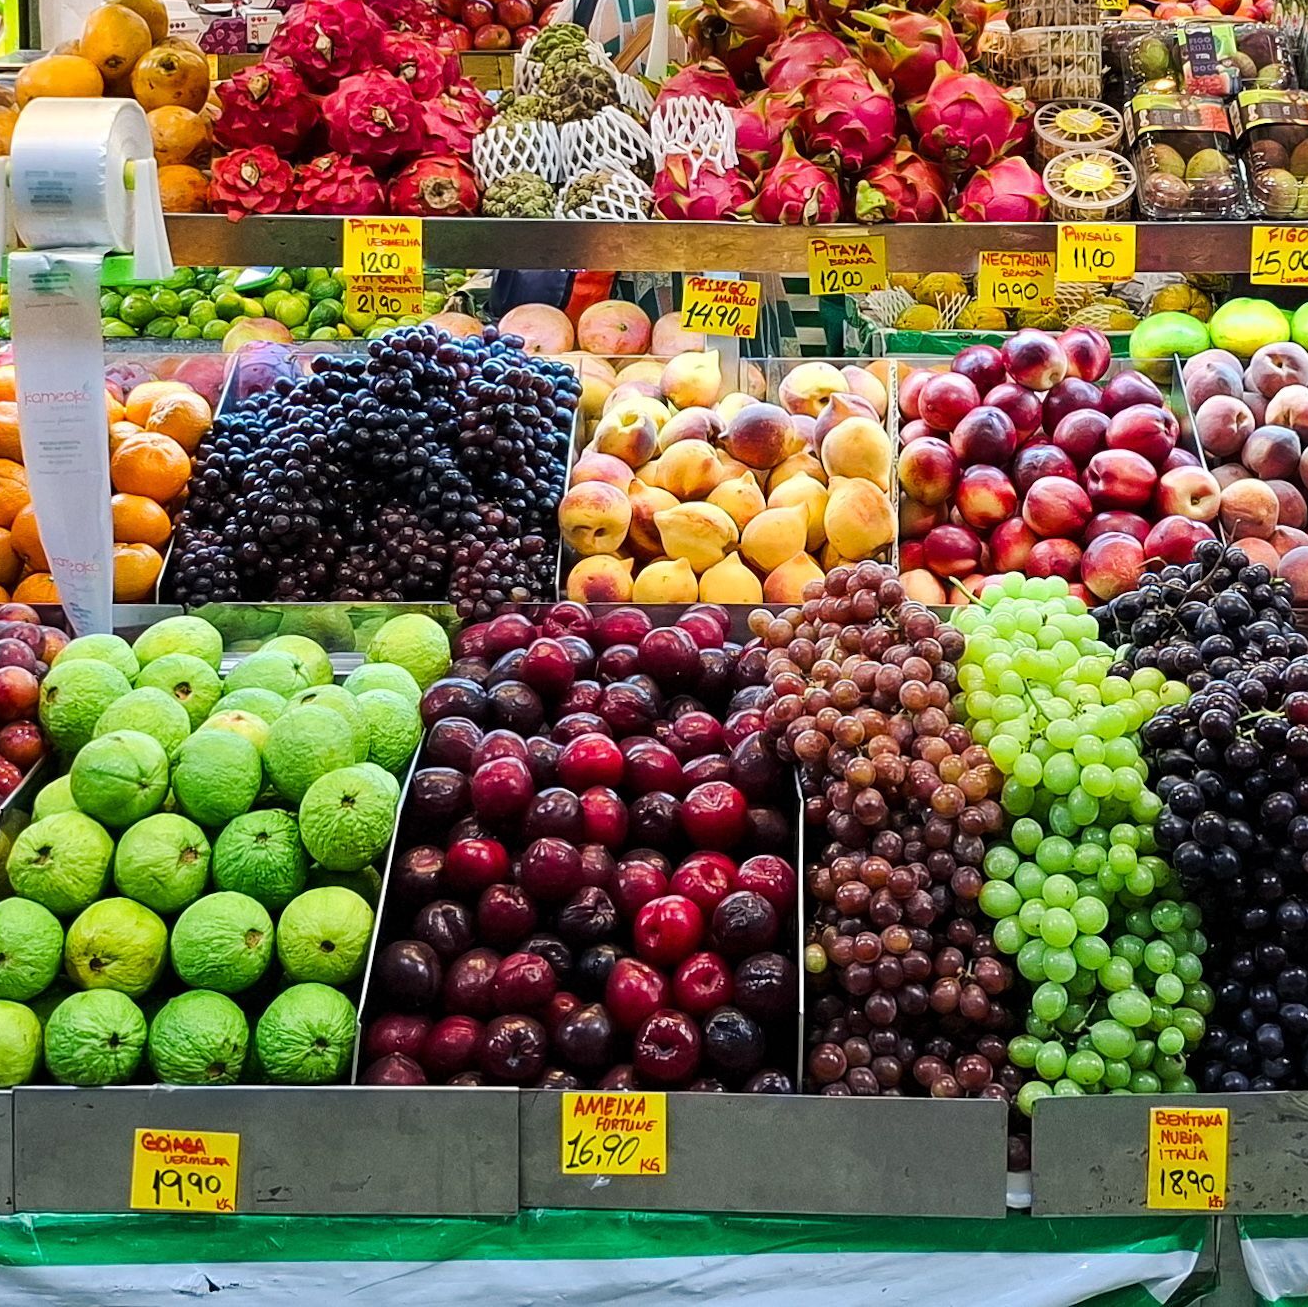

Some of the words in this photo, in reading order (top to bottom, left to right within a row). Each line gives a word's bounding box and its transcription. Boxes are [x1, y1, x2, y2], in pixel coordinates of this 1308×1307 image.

[348, 218, 411, 235] PITAYA
[811, 240, 872, 257] PITAYA
[981, 251, 1051, 267] NECTARINA
[688, 277, 748, 296] PESSEGO
[712, 294, 756, 307] AMARELO
[734, 323, 752, 337] KG
[574, 1095, 646, 1118] AMEIXA
[595, 1117, 658, 1132] FORTUNE
[141, 1132, 207, 1155] GOIABA
[566, 1130, 640, 1169] 16,90
[640, 1157, 660, 1173] KG
[1159, 1146, 1209, 1162] ITALIA
[1160, 1167, 1215, 1200] 18,90
